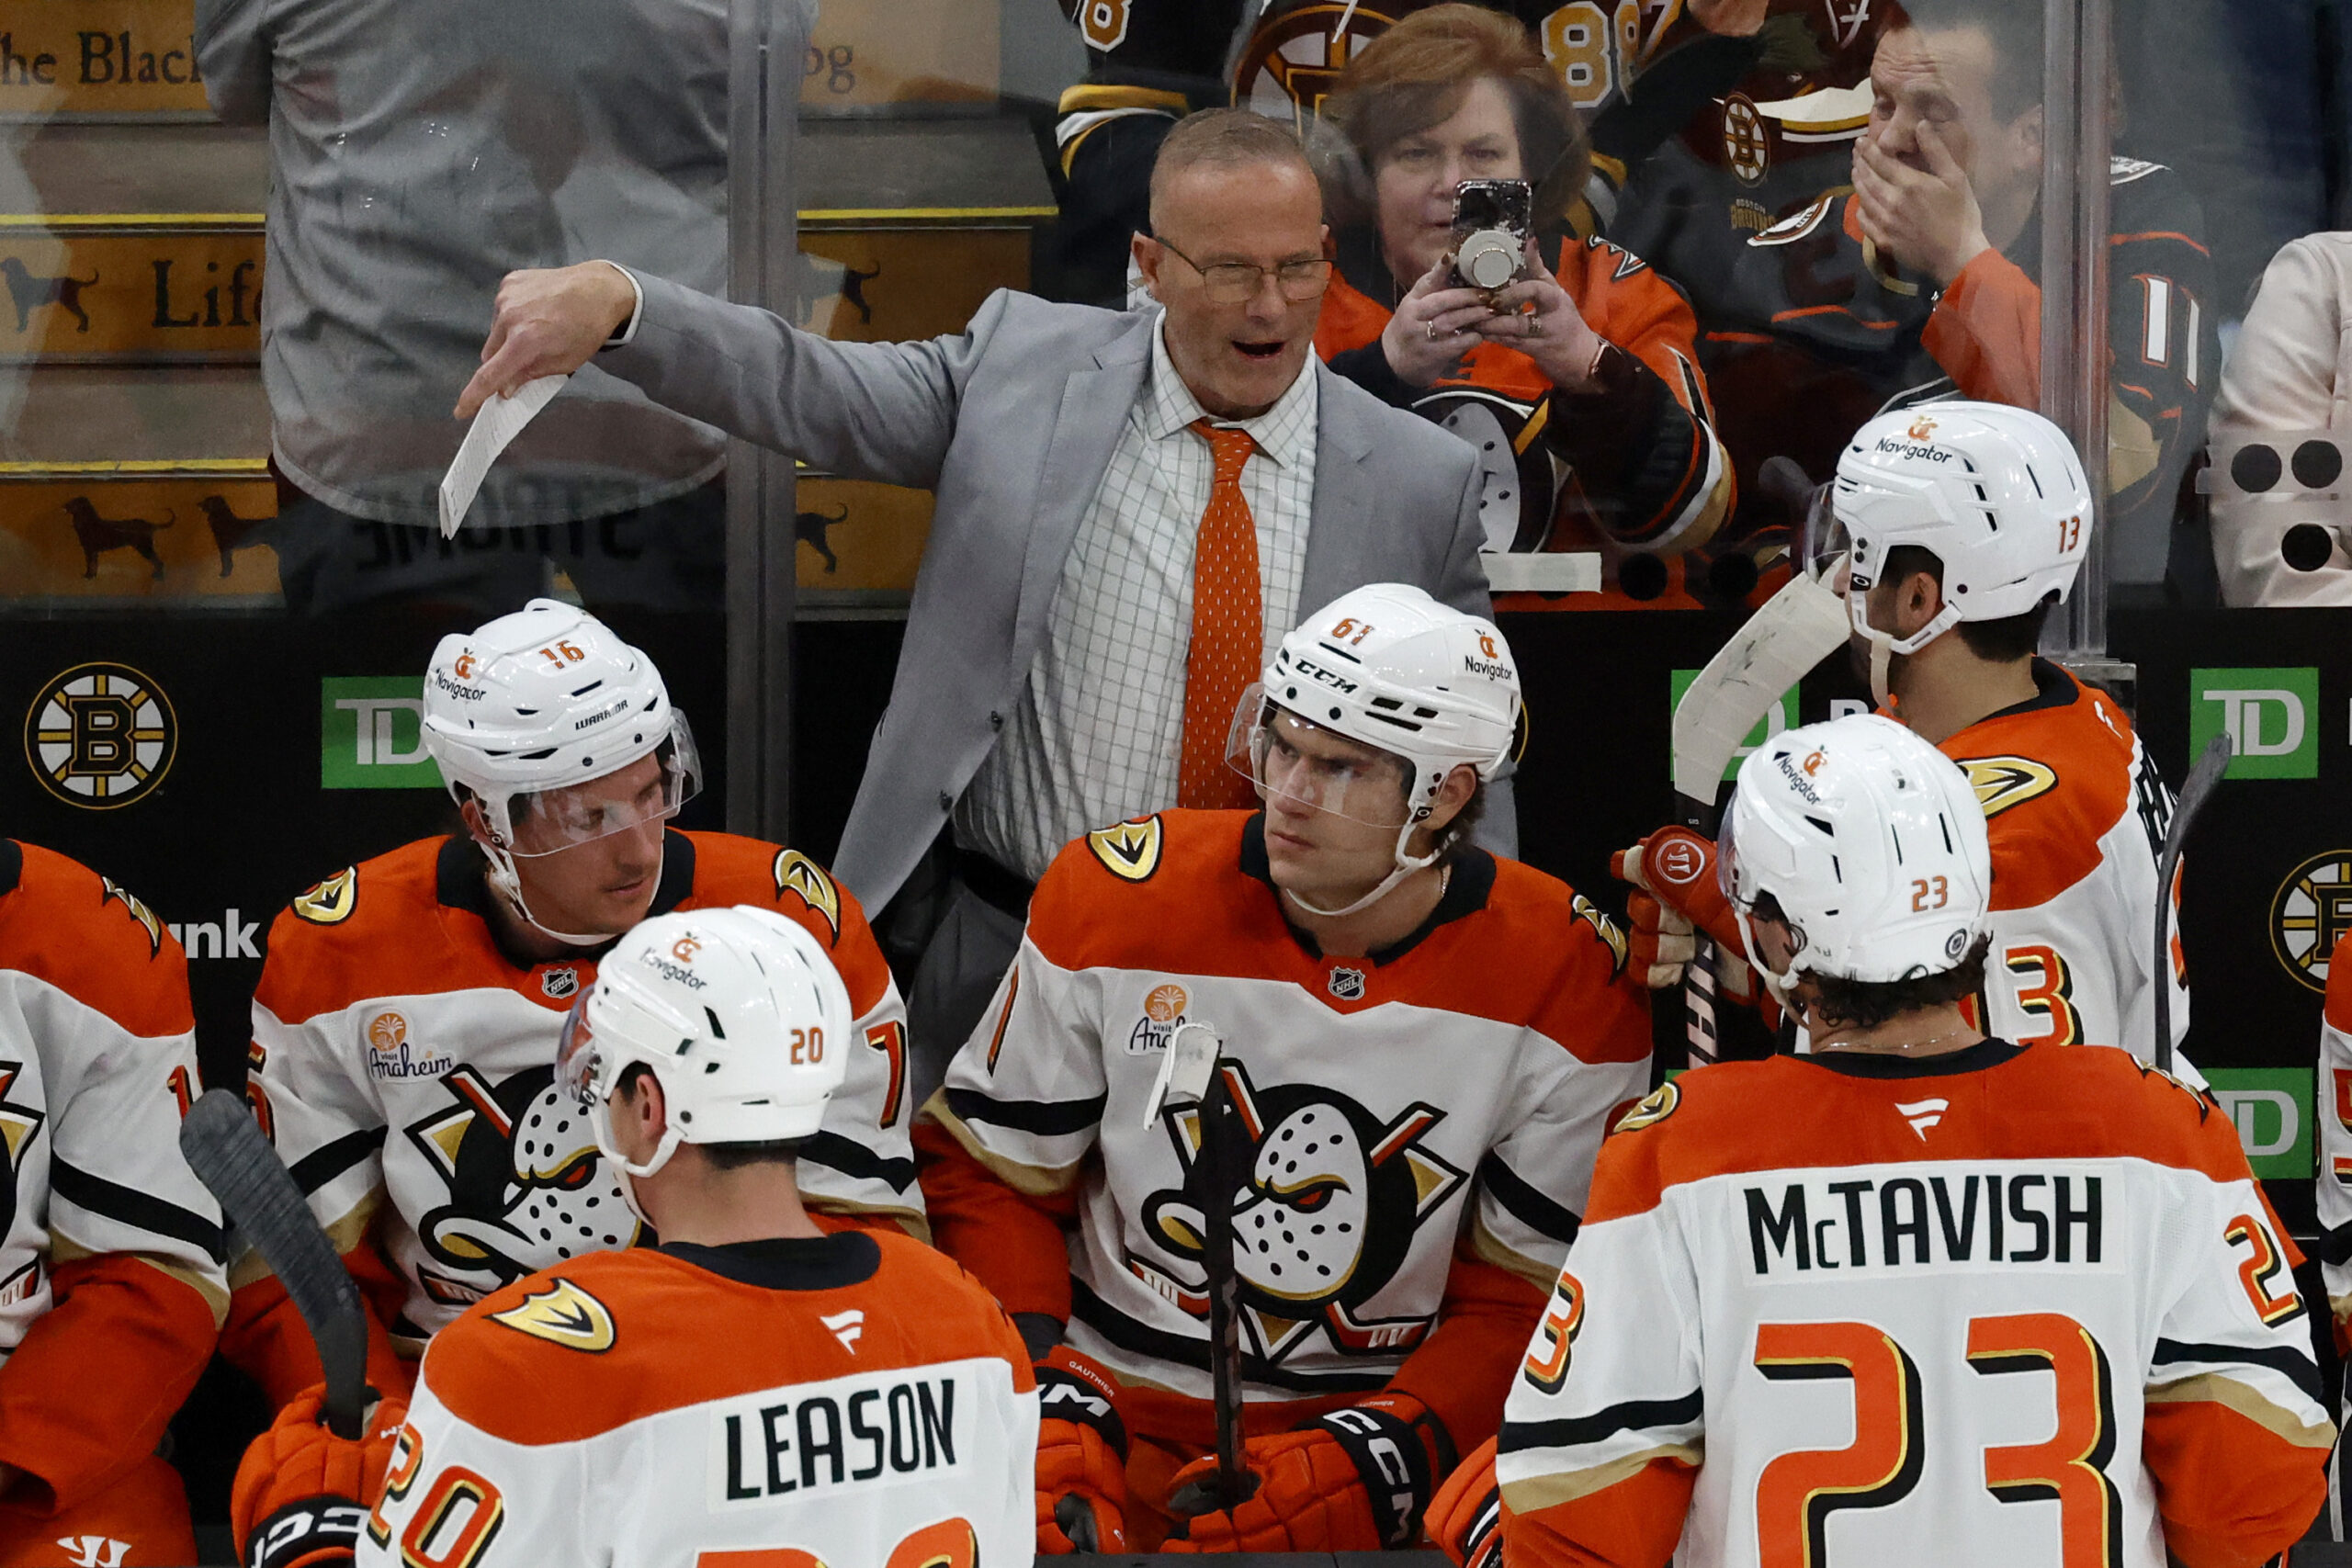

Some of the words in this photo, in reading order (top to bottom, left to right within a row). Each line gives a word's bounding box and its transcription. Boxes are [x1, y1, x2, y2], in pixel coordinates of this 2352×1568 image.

[0, 31, 56, 85] he
[152, 259, 263, 327] Lif
[1875, 438, 1952, 464] Navigator
[2058, 515, 2081, 554] 13
[1331, 617, 1374, 646] 61
[539, 639, 585, 670] 16
[1464, 655, 1512, 682] Navigator
[435, 670, 487, 701] Navigator
[1295, 659, 1359, 694] CCM
[335, 698, 432, 764] TD
[2203, 690, 2304, 756] TD
[1778, 755, 1821, 806] Navigator
[1912, 875, 1949, 913] 23
[369, 1043, 452, 1079] Anaheim
[790, 1027, 824, 1066] 20
[1745, 1175, 2102, 1275] McTAVISH
[1069, 1359, 1115, 1398] GAUTHIER
[726, 1379, 956, 1500] LEASON
[1753, 1313, 2125, 1568] 23
